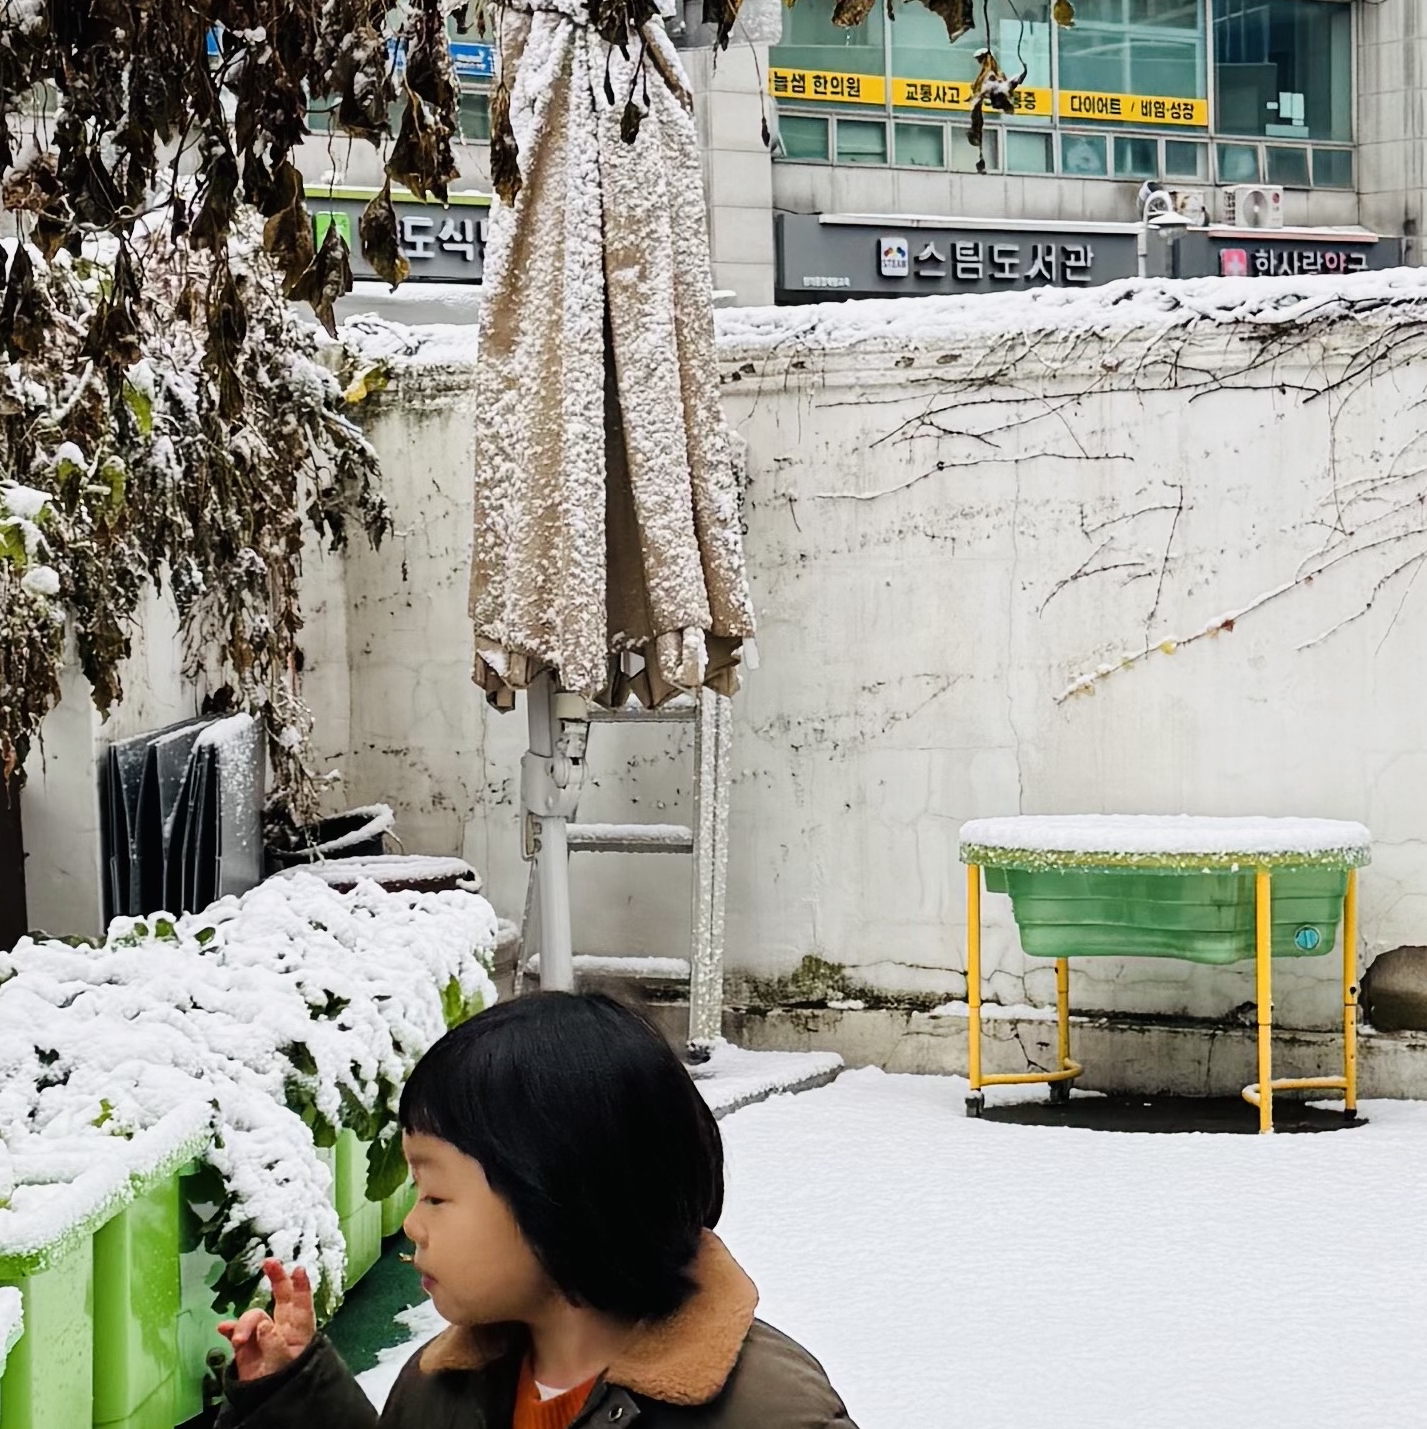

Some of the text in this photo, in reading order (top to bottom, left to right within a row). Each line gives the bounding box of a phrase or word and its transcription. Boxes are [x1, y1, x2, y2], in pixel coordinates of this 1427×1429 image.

[769, 71, 860, 98] 늘샘 한의원
[905, 83, 960, 104] 교통사고
[1070, 95, 1122, 115] 다이어트
[396, 215, 489, 262] 도식
[917, 240, 1095, 282] 스팀도서관
